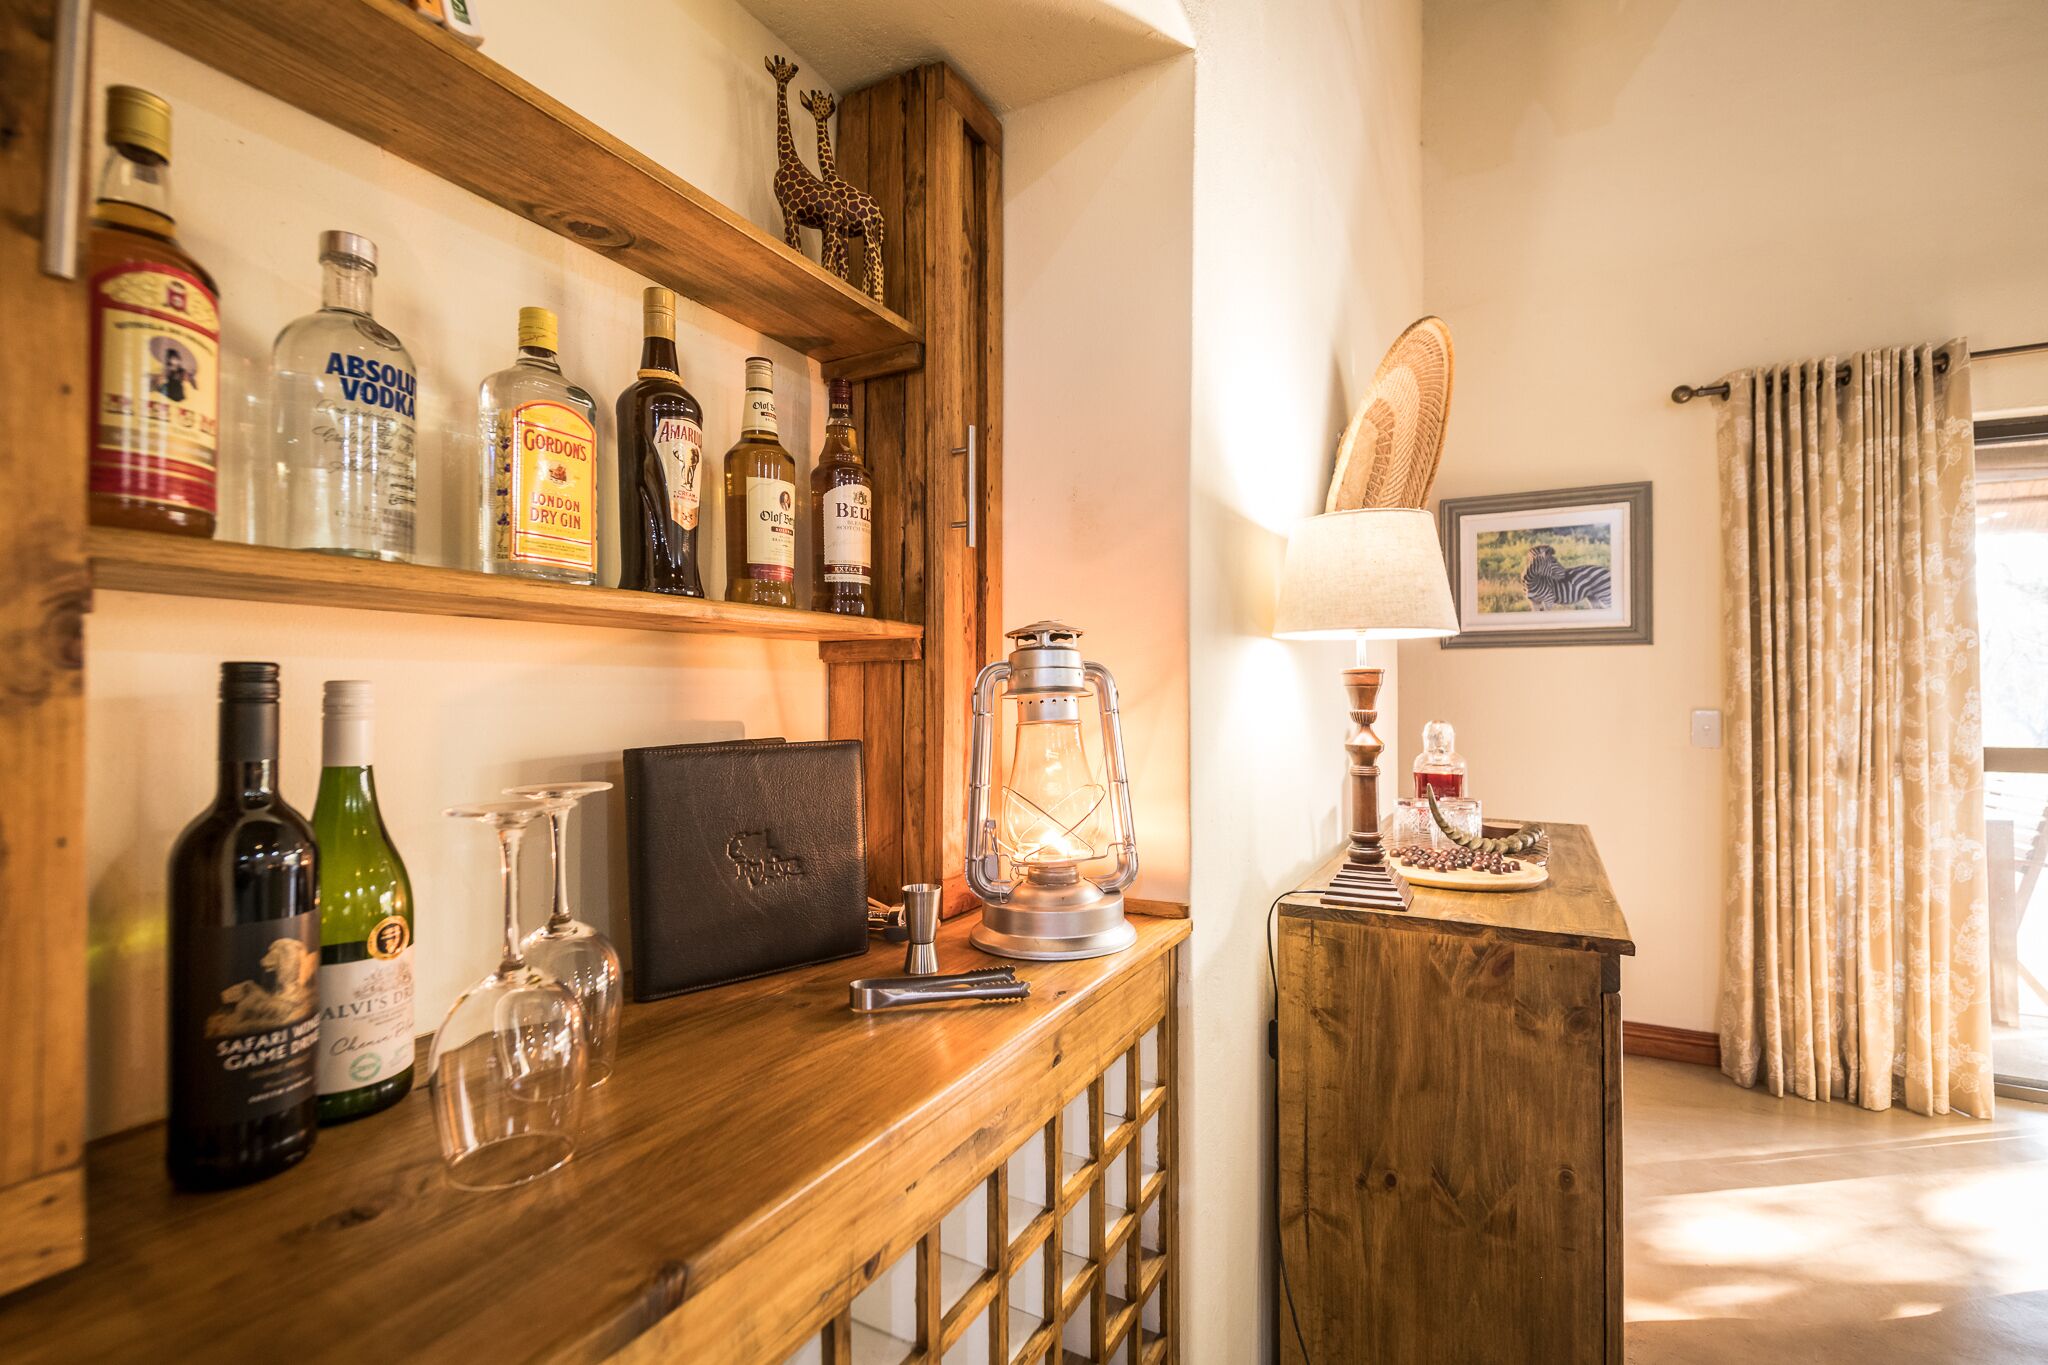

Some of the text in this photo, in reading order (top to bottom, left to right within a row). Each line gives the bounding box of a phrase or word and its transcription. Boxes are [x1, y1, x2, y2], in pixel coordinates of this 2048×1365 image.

[339, 377, 416, 421] VODKA
[523, 428, 587, 462] GORDON'S
[531, 491, 580, 513] LONDON
[530, 507, 557, 525] DRY
[560, 512, 582, 530] GIN
[760, 510, 782, 525] Olof
[216, 1028, 289, 1057] SAFARI
[223, 1044, 288, 1071] GAME
